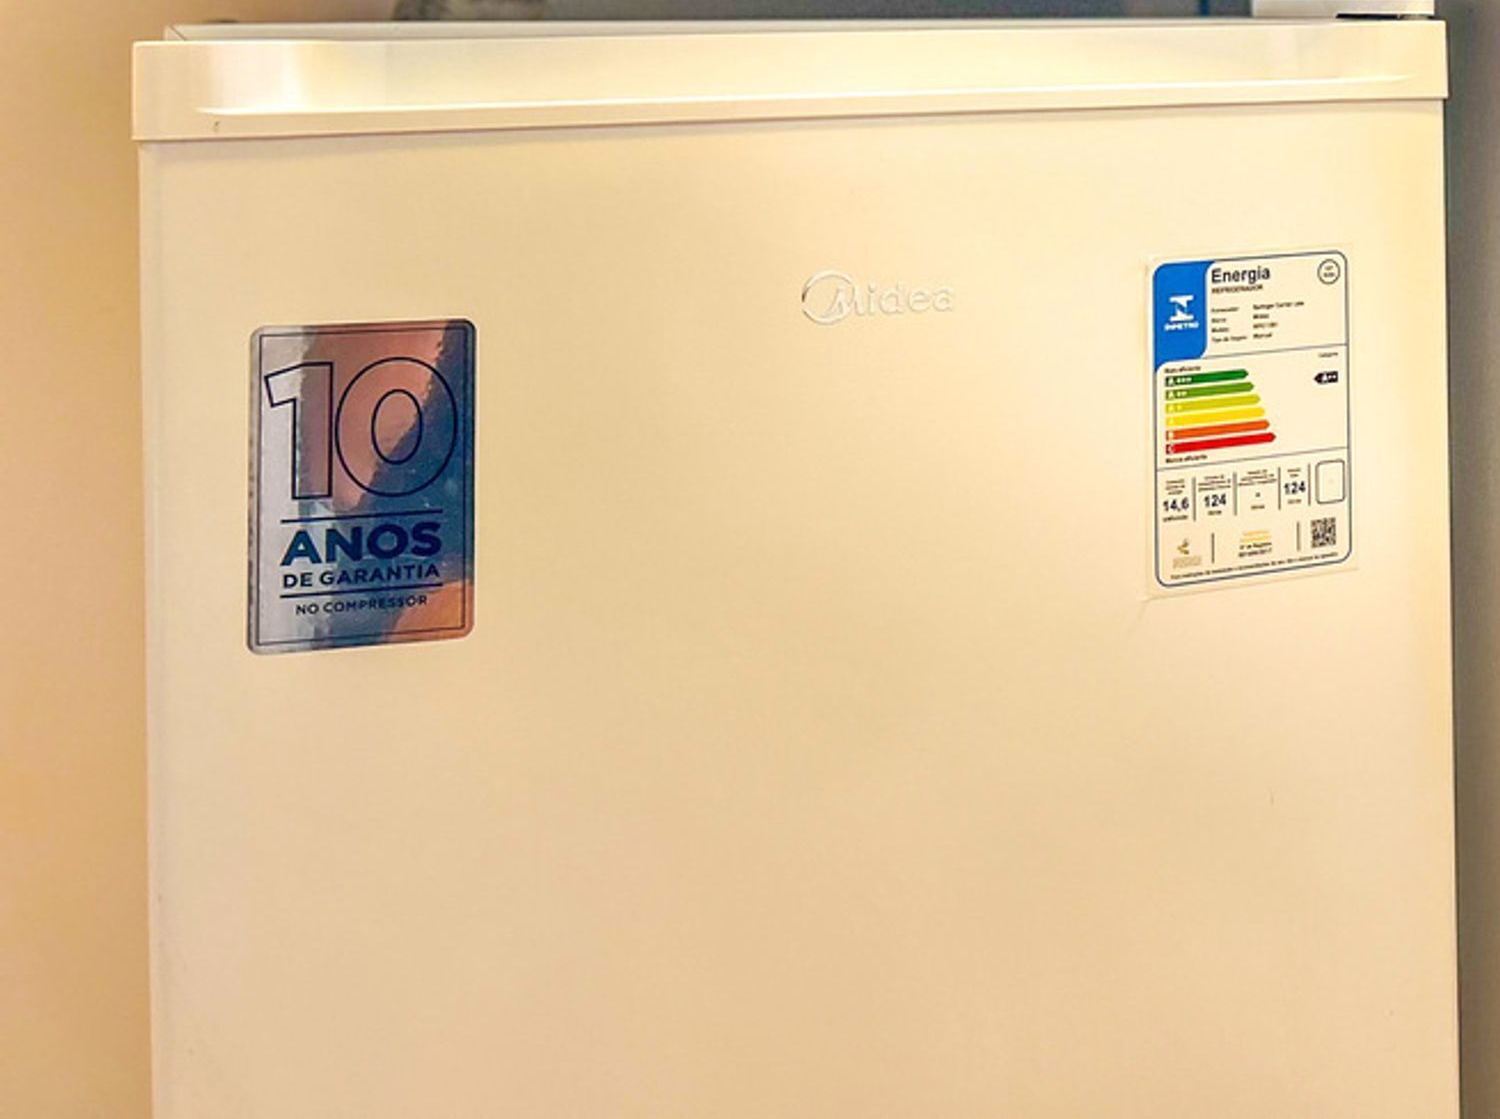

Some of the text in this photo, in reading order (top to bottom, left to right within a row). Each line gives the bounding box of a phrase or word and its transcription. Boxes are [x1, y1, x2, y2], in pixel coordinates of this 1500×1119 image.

[1211, 266, 1271, 284] Energia
[801, 269, 955, 325] Midea
[264, 356, 459, 500] 10
[1283, 481, 1306, 495] 124
[1163, 497, 1190, 513] 14,6
[1203, 494, 1227, 508] 124
[280, 521, 443, 566] ANOS
[283, 564, 440, 589] DE GARANTIA
[296, 595, 428, 616] NO COMPRESSOR
